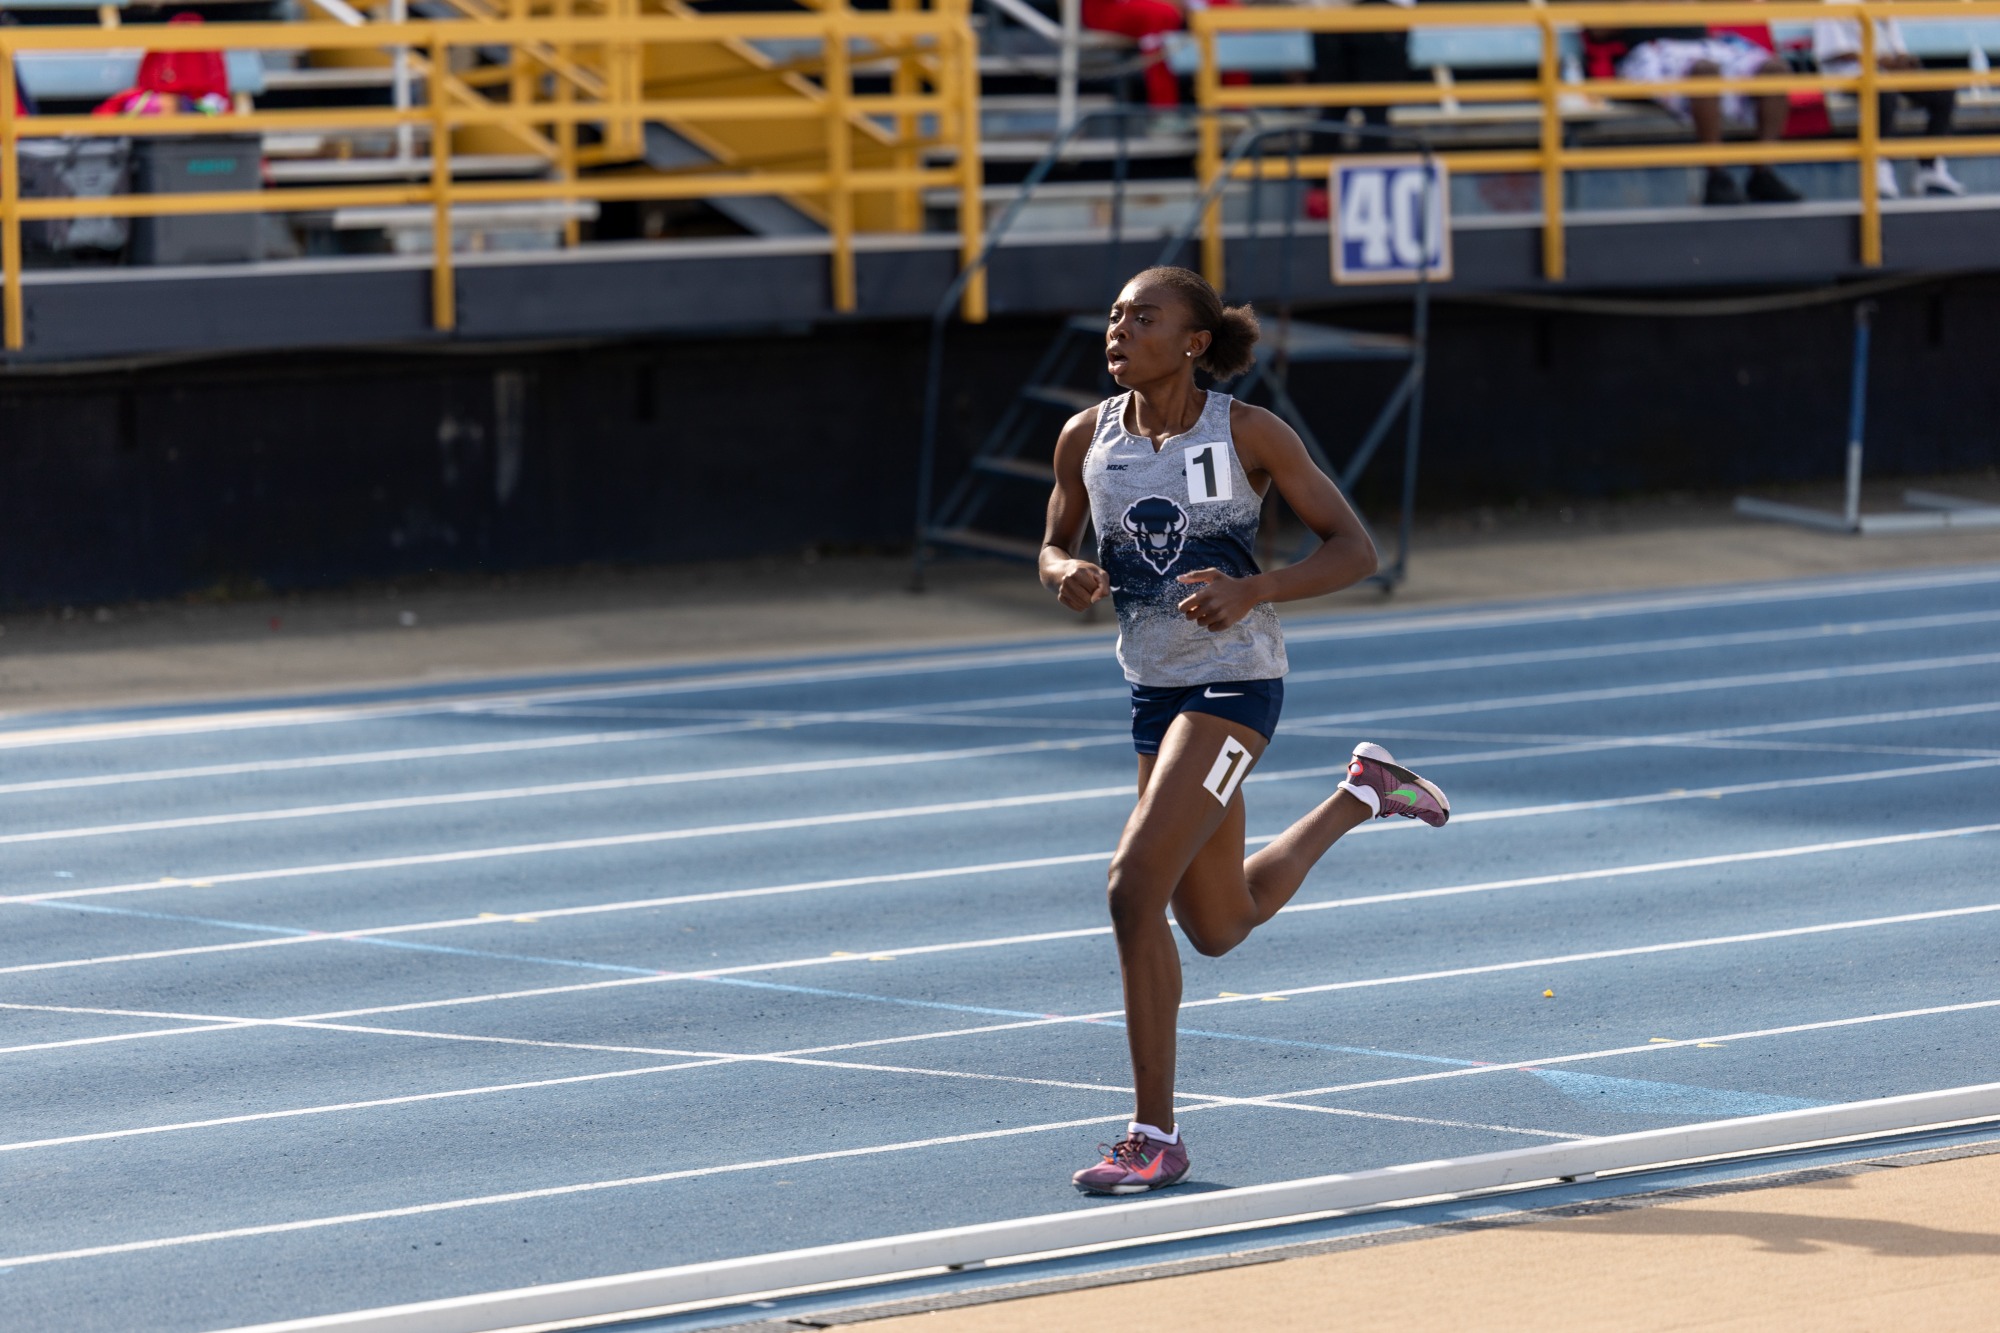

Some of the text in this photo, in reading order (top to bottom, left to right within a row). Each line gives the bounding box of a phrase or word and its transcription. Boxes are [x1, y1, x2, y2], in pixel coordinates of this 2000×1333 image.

[1342, 171, 1440, 265] 40
[1192, 446, 1218, 498] 1
[1215, 749, 1245, 796] 1
